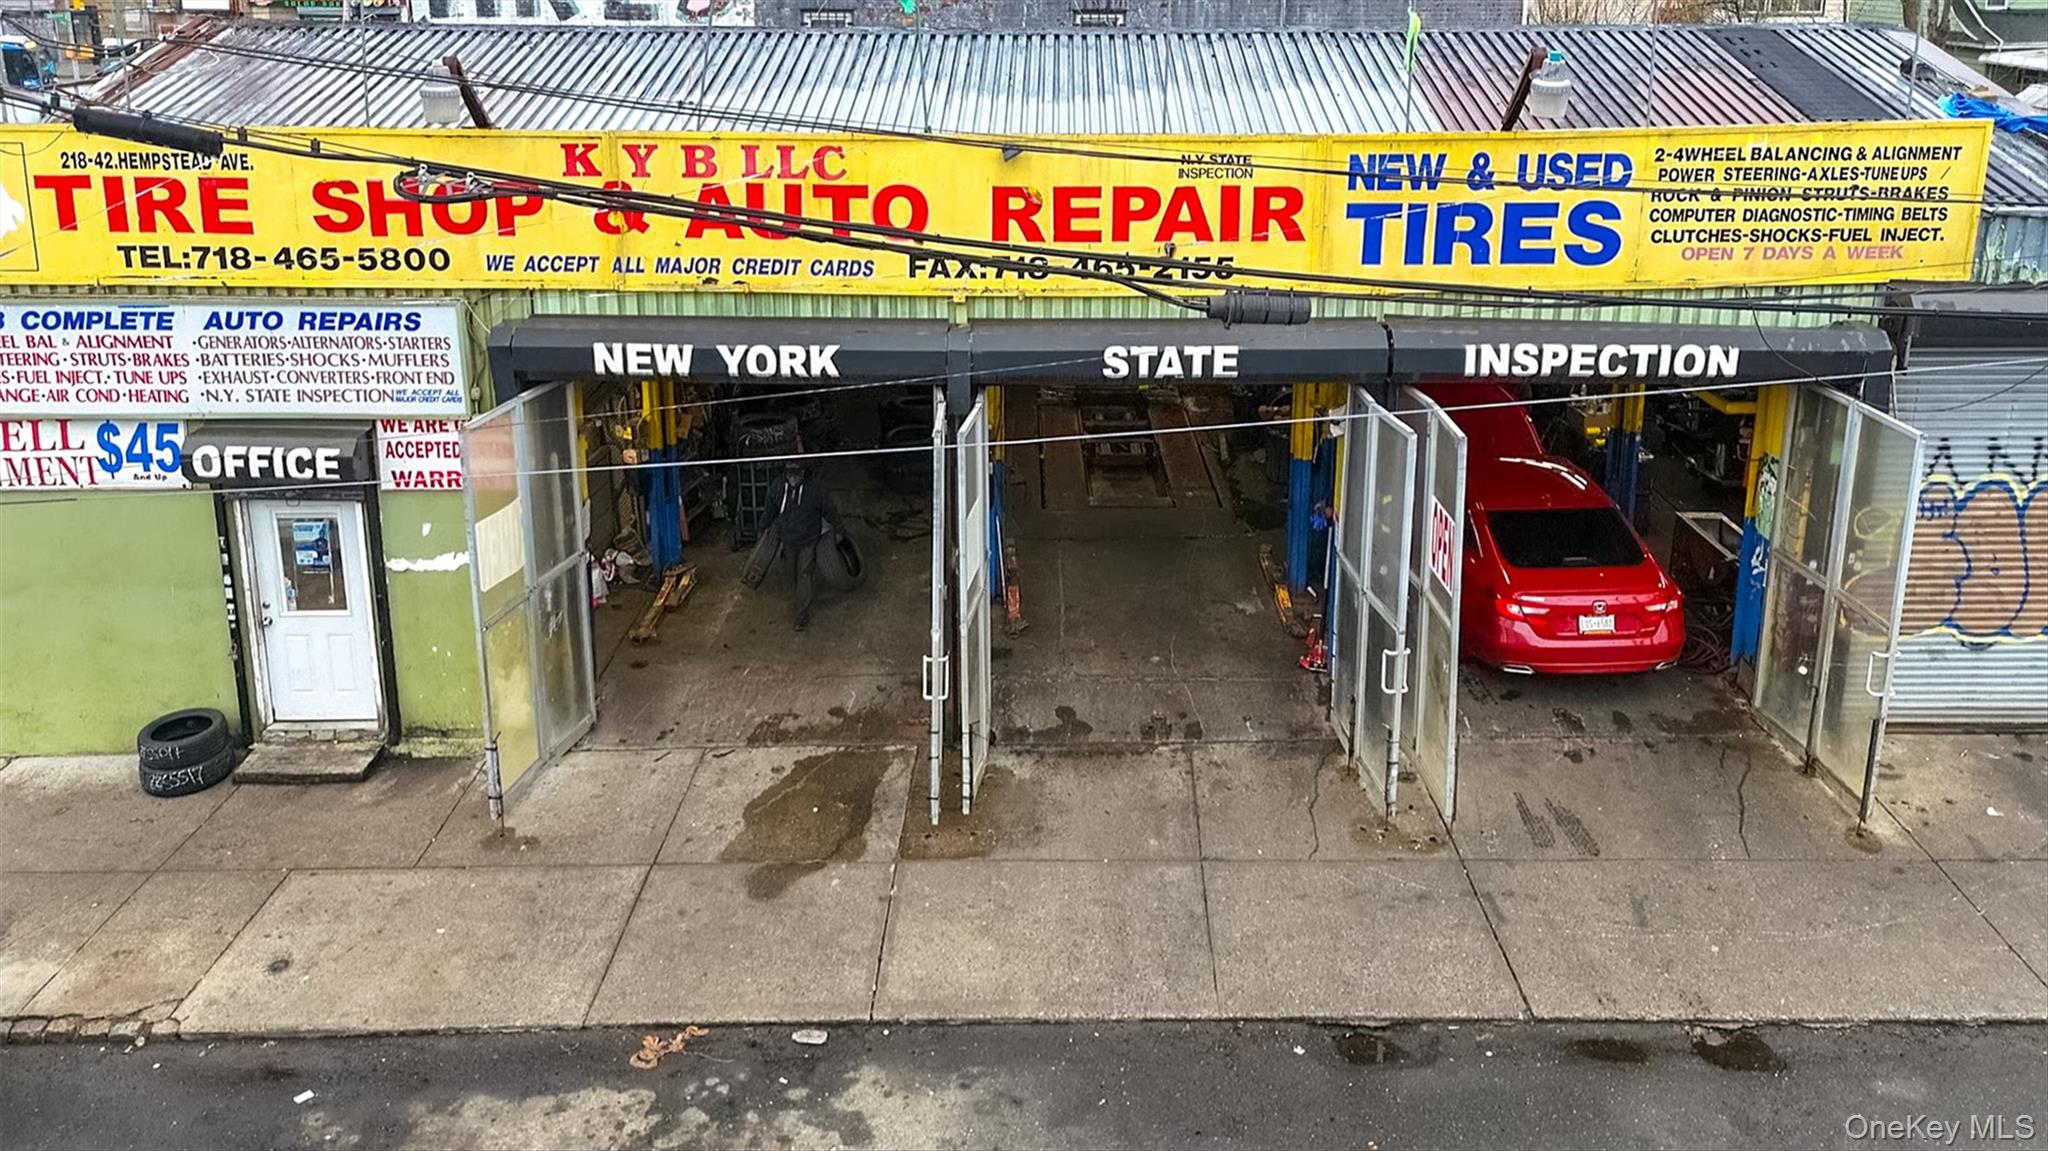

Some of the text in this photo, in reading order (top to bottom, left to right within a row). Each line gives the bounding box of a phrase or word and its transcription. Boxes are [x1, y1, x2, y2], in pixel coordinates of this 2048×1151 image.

[221, 153, 254, 171] AVE.
[561, 143, 848, 181] K Y B LLC
[1655, 146, 1963, 162] 2-4WHEEL BALANCING & ALIGNMENT
[1177, 167, 1254, 180] INSPECTION
[1348, 151, 1633, 191] NEW & USED
[1658, 167, 1715, 182] POWER
[34, 174, 1307, 243] TIRE SHOP & AUTO REPAIR
[1649, 207, 1948, 222] COMPUTER DIAGNOSTIC-TIMING BELTS
[1346, 200, 1622, 266] TIRES
[1880, 227, 1945, 242] INJECT.
[1681, 245, 1904, 261] OPEN 7 DAYS A WEEK
[486, 254, 874, 278] WE ACCEPT ALL MAJOR CREDIT CARDS
[21, 311, 175, 331] COMPLETE
[203, 311, 283, 331] AUTO
[298, 311, 422, 332] REPAIRS
[26, 334, 57, 349] BAL
[62, 337, 70, 346] &
[76, 334, 174, 349] ALIGNMENT
[593, 342, 841, 378] NEW YORK
[1102, 345, 1239, 379] STATE
[1463, 343, 1741, 378] INSPECTION
[159, 371, 188, 385] UPS
[426, 371, 455, 385] END
[245, 388, 292, 403] STATE
[297, 388, 394, 403] INSPECTION
[380, 419, 408, 433] WE
[414, 419, 449, 433] ARE
[97, 419, 181, 479] $45
[386, 441, 461, 458] ACCEPTED
[191, 444, 341, 480] OFFICE
[0, 456, 101, 487] MENT
[154, 473, 168, 482] Up
[391, 471, 463, 488] WARR
[1431, 500, 1456, 594] OPEN
